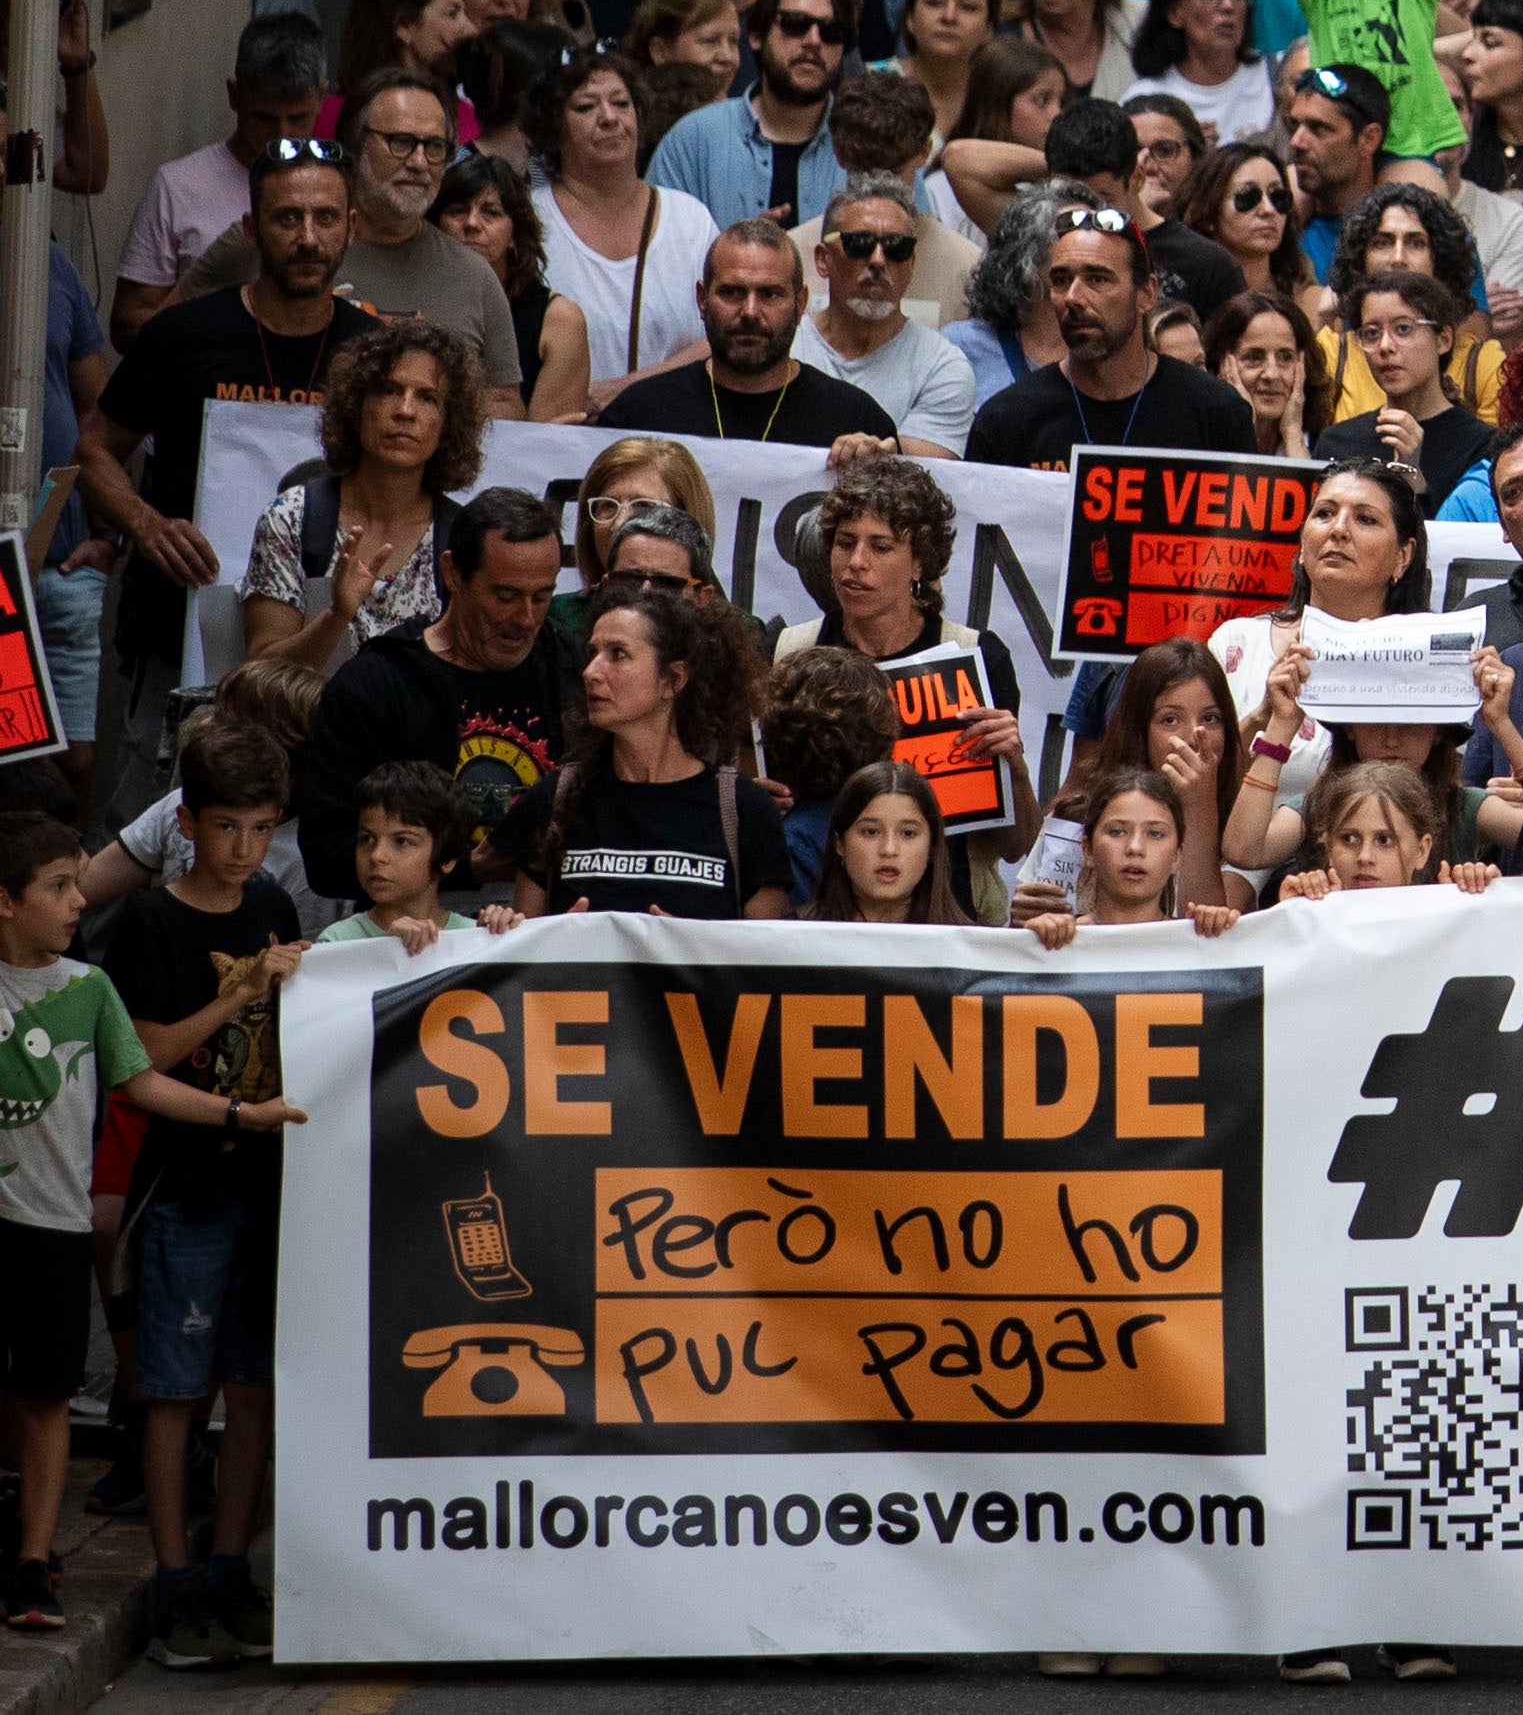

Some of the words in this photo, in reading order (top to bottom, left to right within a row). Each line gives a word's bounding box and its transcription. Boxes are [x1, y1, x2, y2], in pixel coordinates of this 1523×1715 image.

[1082, 465, 1147, 523] SE
[1161, 469, 1320, 534] VEND
[1137, 539, 1199, 568] DRET
[1202, 545, 1222, 567] A
[1228, 544, 1280, 572] UNA
[1363, 648, 1424, 663] FUTURO
[888, 668, 980, 726] UILA
[561, 855, 647, 874] STRANGIS
[654, 856, 725, 883] GUAJES
[1053, 859, 1075, 875] SIN
[415, 990, 612, 1139] SE
[664, 992, 1206, 1140] VENDE
[603, 1178, 837, 1281] Però
[875, 1199, 1003, 1276] no
[1058, 1183, 1200, 1283] ho
[621, 1319, 798, 1424] puc
[858, 1306, 1167, 1423] pagar
[366, 1479, 1267, 1552] mallorcanoesven.com
